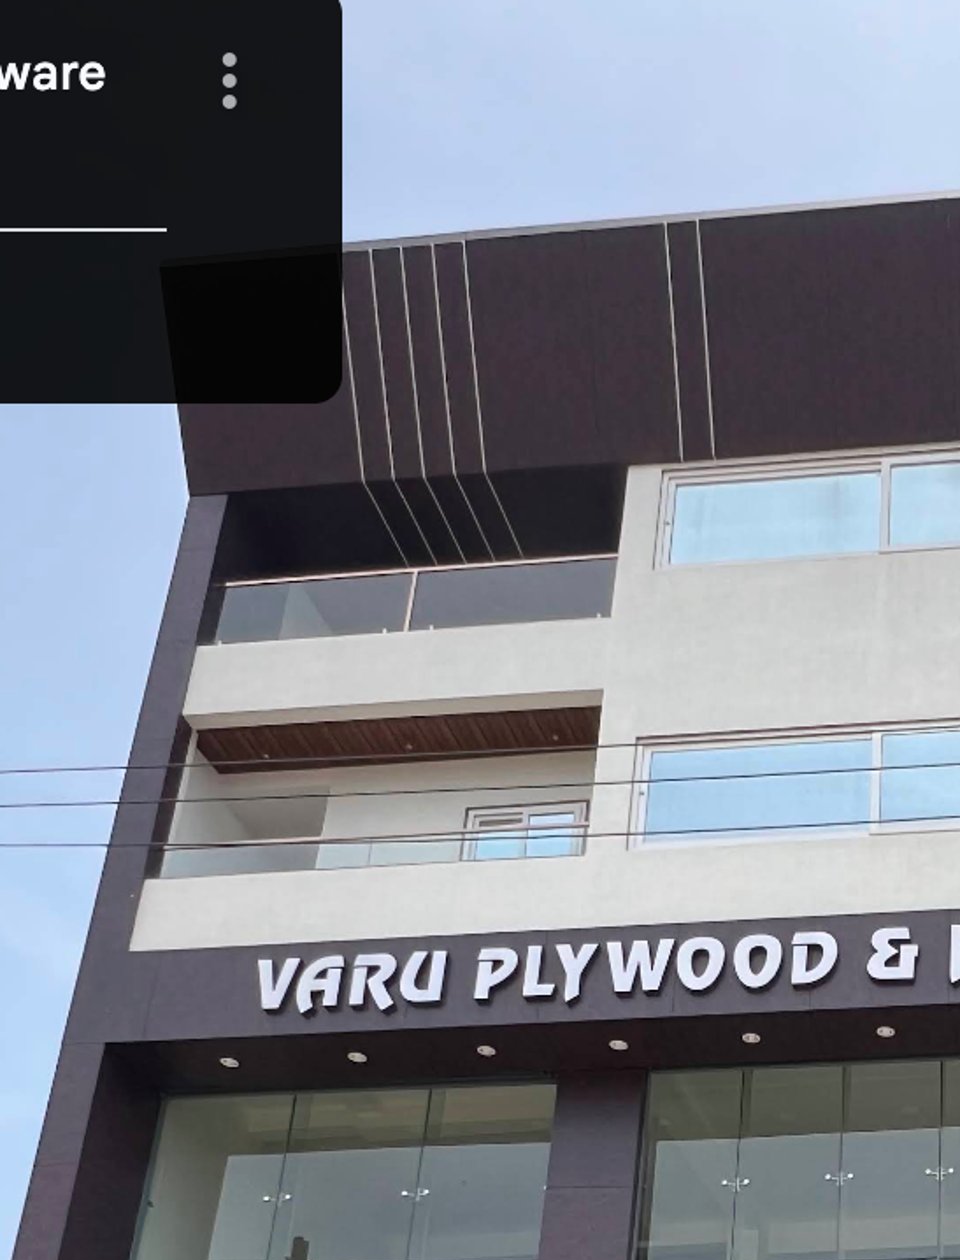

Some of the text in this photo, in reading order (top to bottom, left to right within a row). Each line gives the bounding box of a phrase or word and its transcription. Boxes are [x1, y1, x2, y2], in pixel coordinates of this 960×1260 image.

[257, 950, 447, 1013] VARU
[473, 931, 838, 1002] PLYWOOD
[866, 926, 919, 981] &
